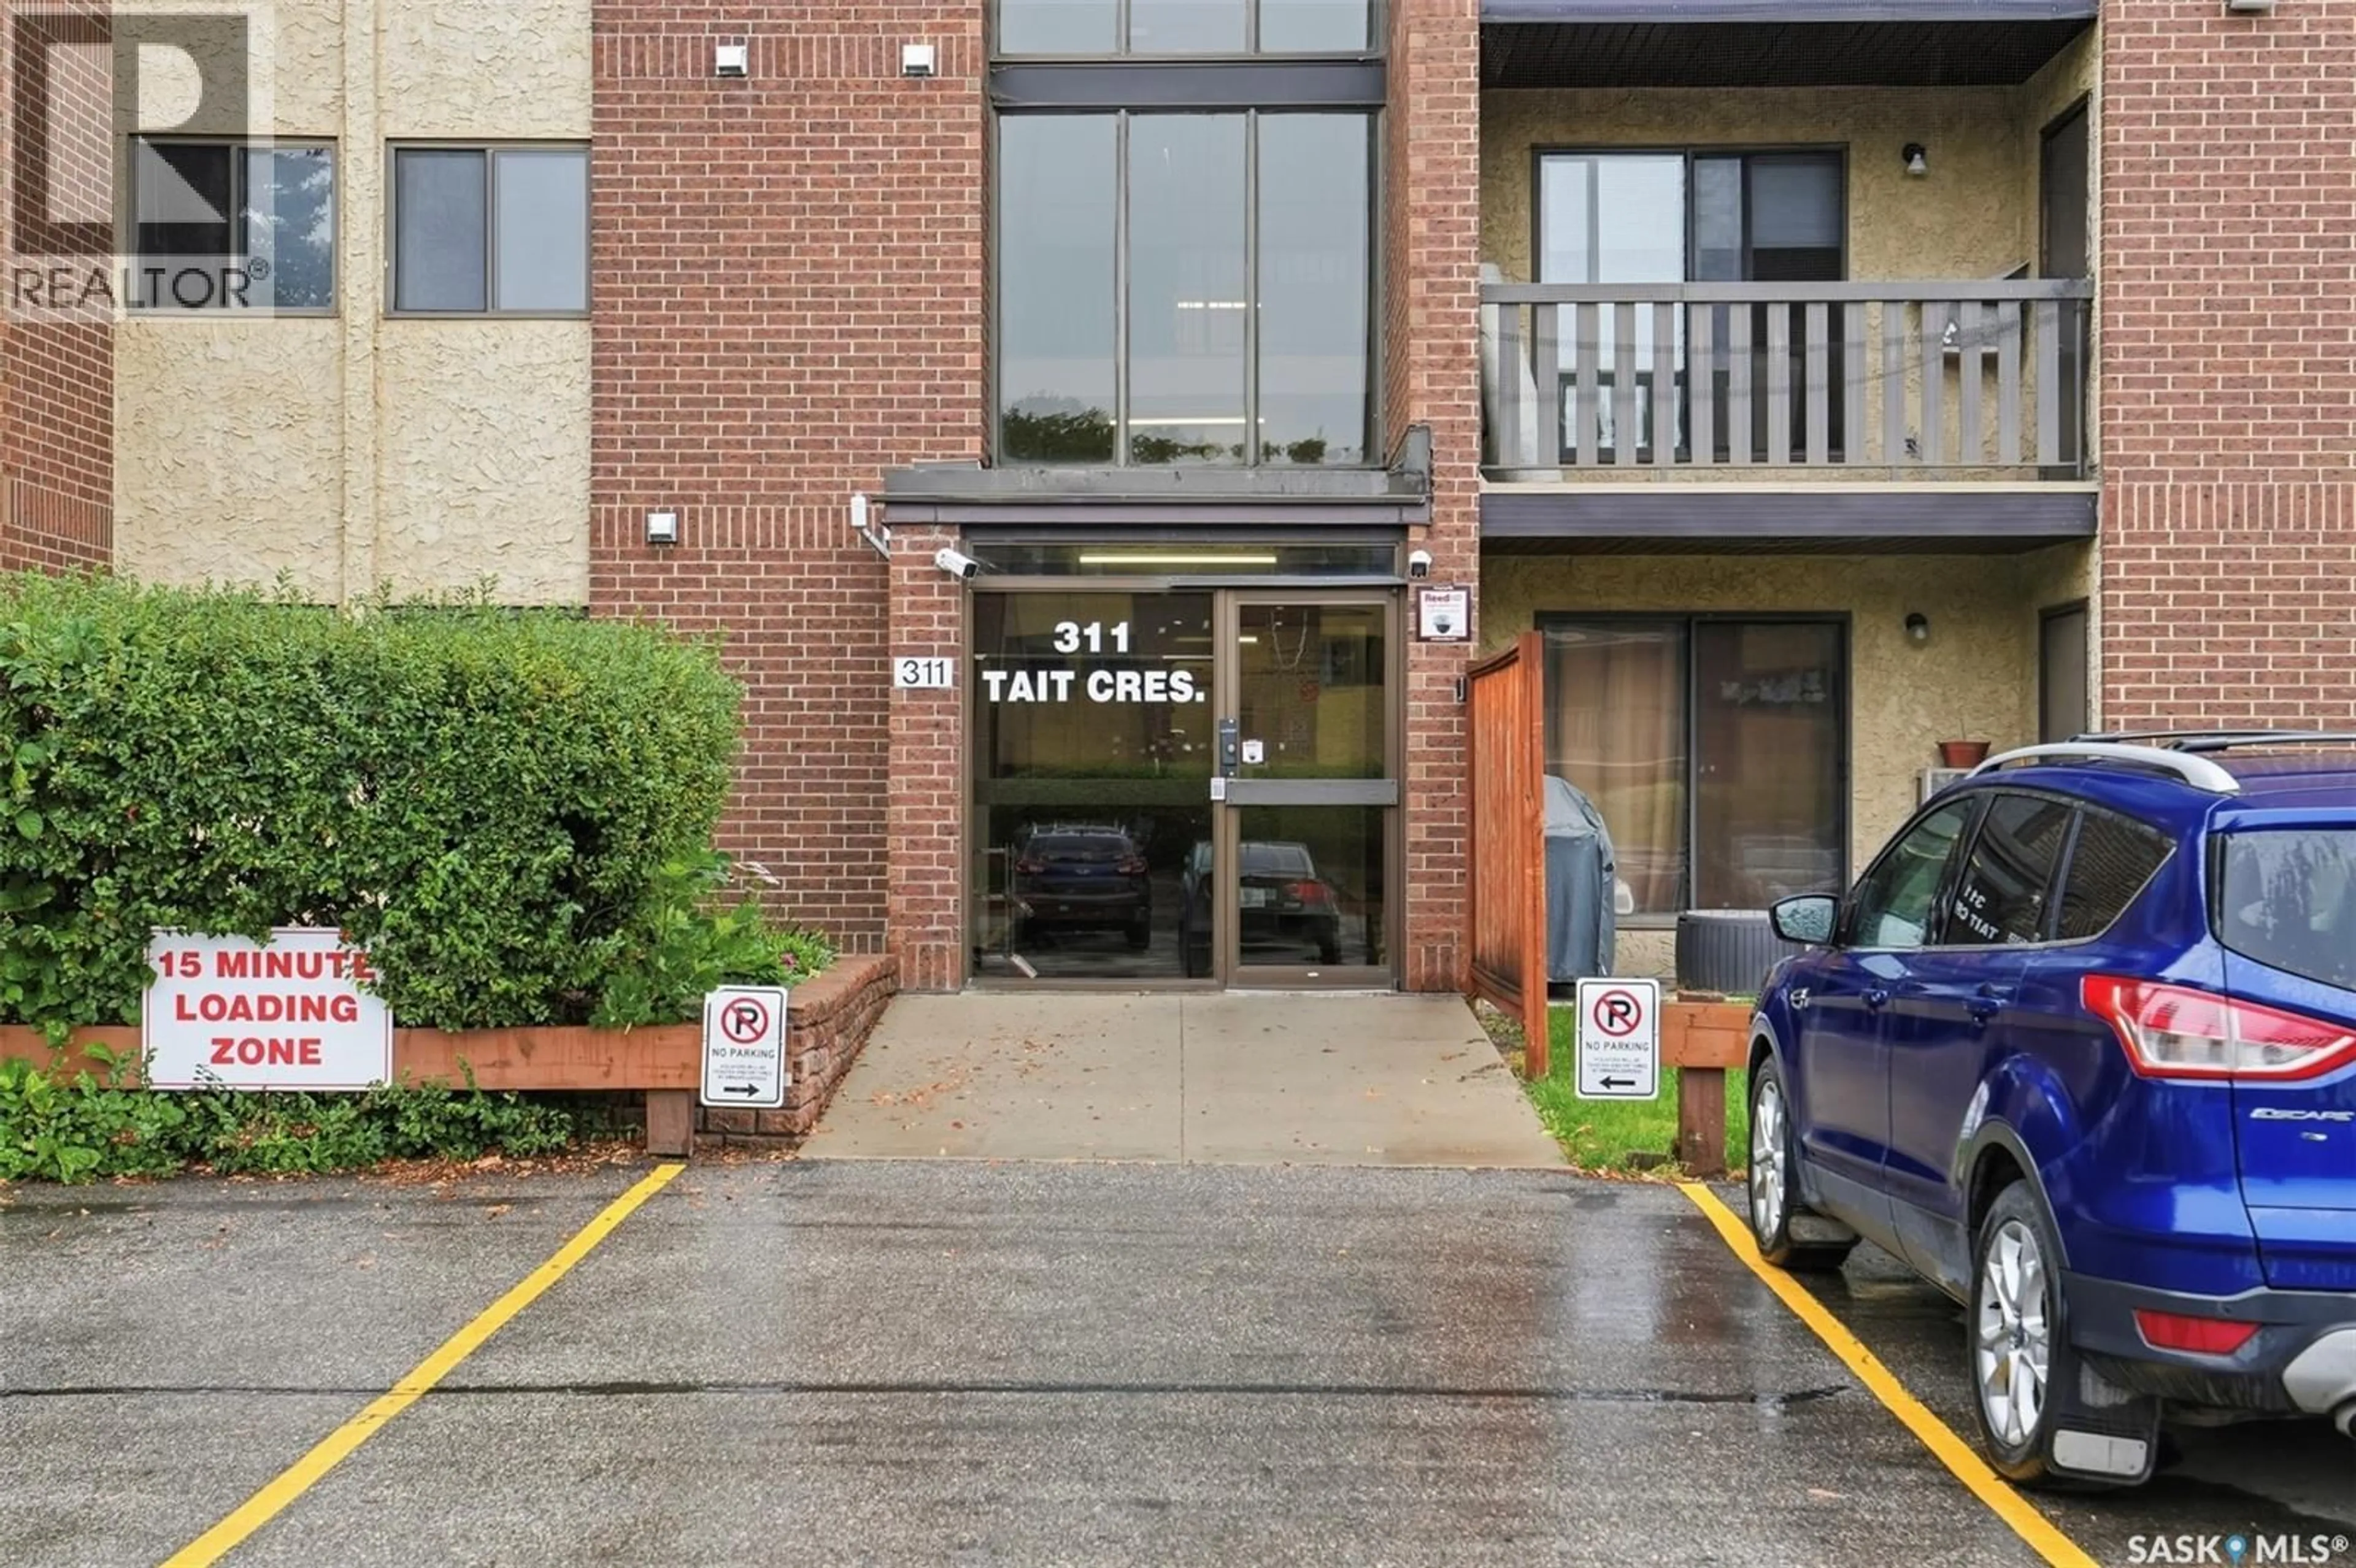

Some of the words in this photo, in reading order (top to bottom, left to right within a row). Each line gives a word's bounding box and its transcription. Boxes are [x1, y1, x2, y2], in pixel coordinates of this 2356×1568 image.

[1053, 621, 1130, 653] 311
[902, 659, 945, 685] 311
[982, 671, 1075, 702] TAIT
[1087, 671, 1205, 702] CRES.
[159, 951, 201, 978] 15
[175, 994, 358, 1022] LOADING
[210, 1038, 322, 1065] ZONE
[712, 1048, 727, 1058] NO
[730, 1048, 776, 1059] PARKING
[1585, 1042, 1600, 1050] NO
[1603, 1042, 1650, 1052] PARKING
